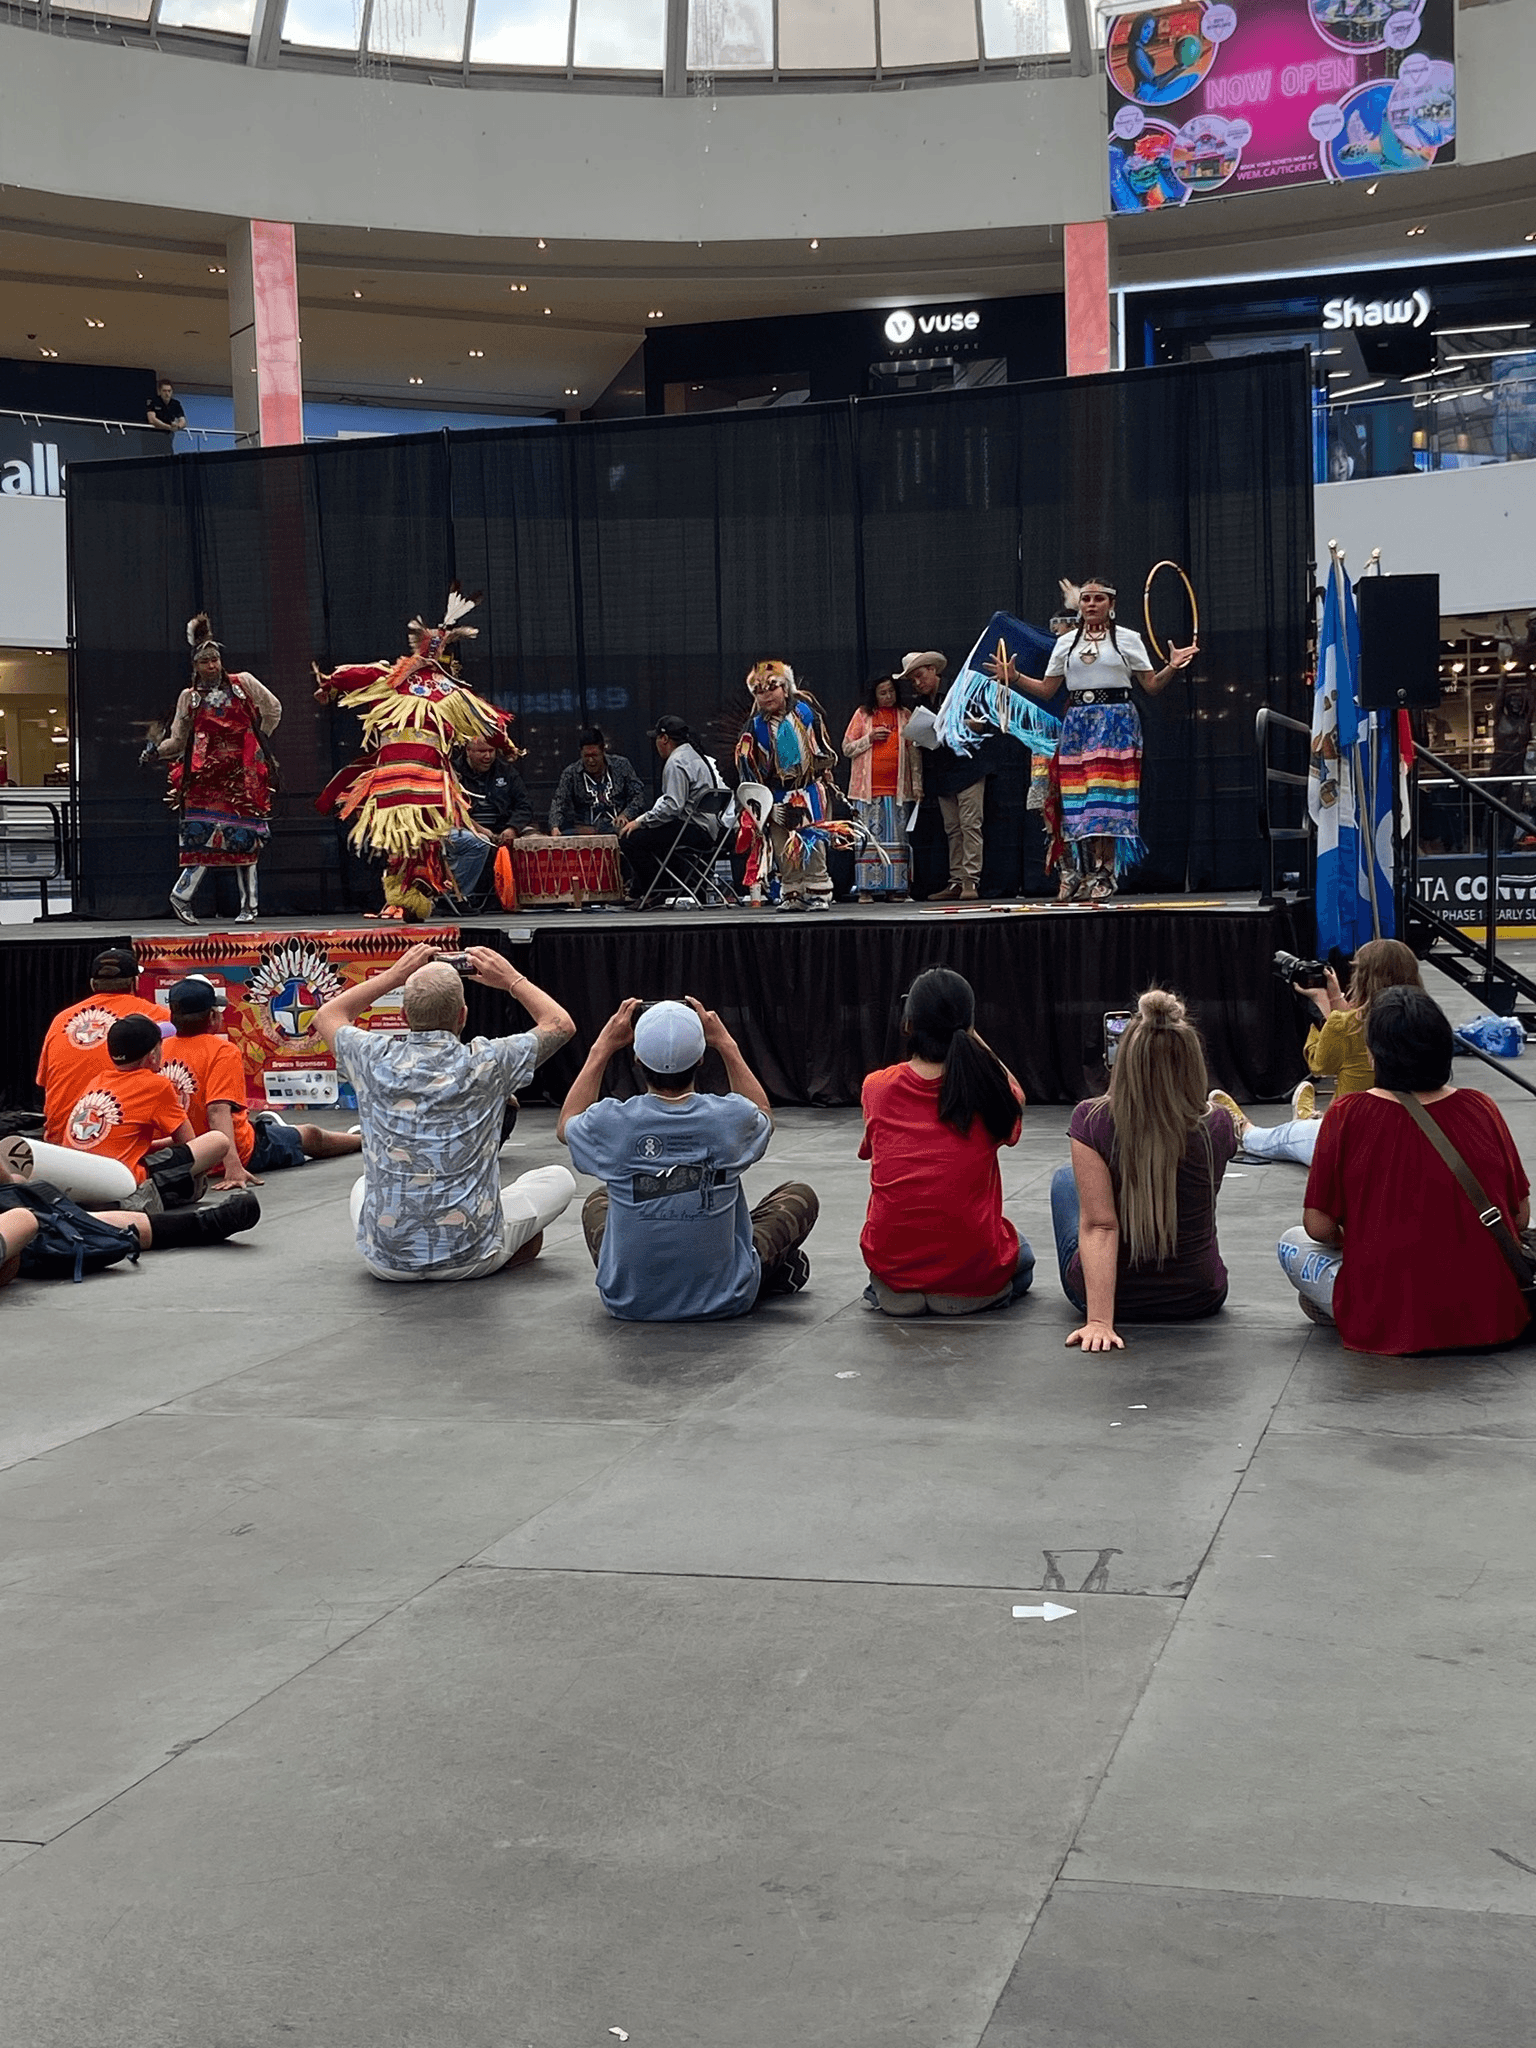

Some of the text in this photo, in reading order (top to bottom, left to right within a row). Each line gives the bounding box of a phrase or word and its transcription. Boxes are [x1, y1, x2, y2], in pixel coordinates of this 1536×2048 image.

[1205, 56, 1356, 110] NOW OPEN
[1236, 160, 1319, 181] WEM.CA/TICKETS
[918, 311, 980, 334] vuse
[889, 342, 979, 356] VAPE STORE
[1416, 877, 1449, 902] TA
[1442, 909, 1477, 921] PHASE
